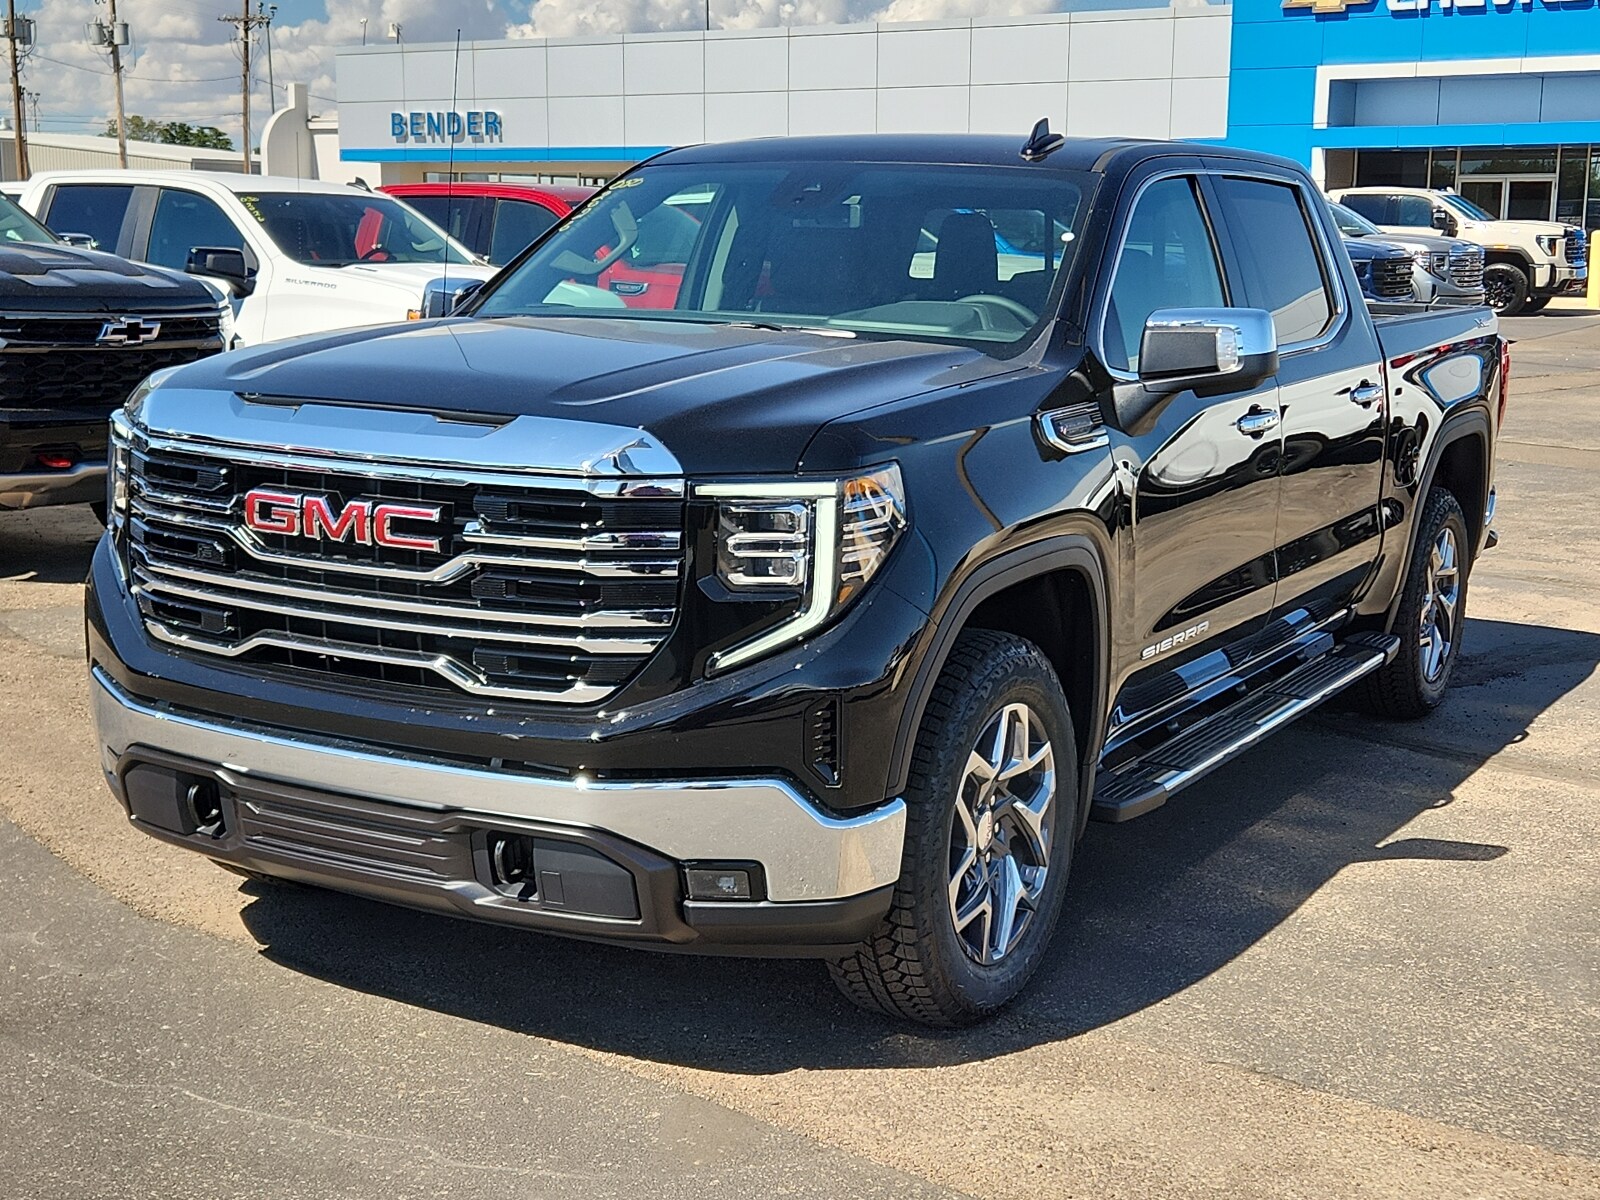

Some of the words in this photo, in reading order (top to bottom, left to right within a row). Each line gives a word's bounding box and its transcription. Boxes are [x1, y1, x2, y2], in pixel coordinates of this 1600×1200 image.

[390, 111, 502, 138] BENDER
[244, 488, 442, 553] GMC
[1139, 620, 1209, 660] SIERRA
